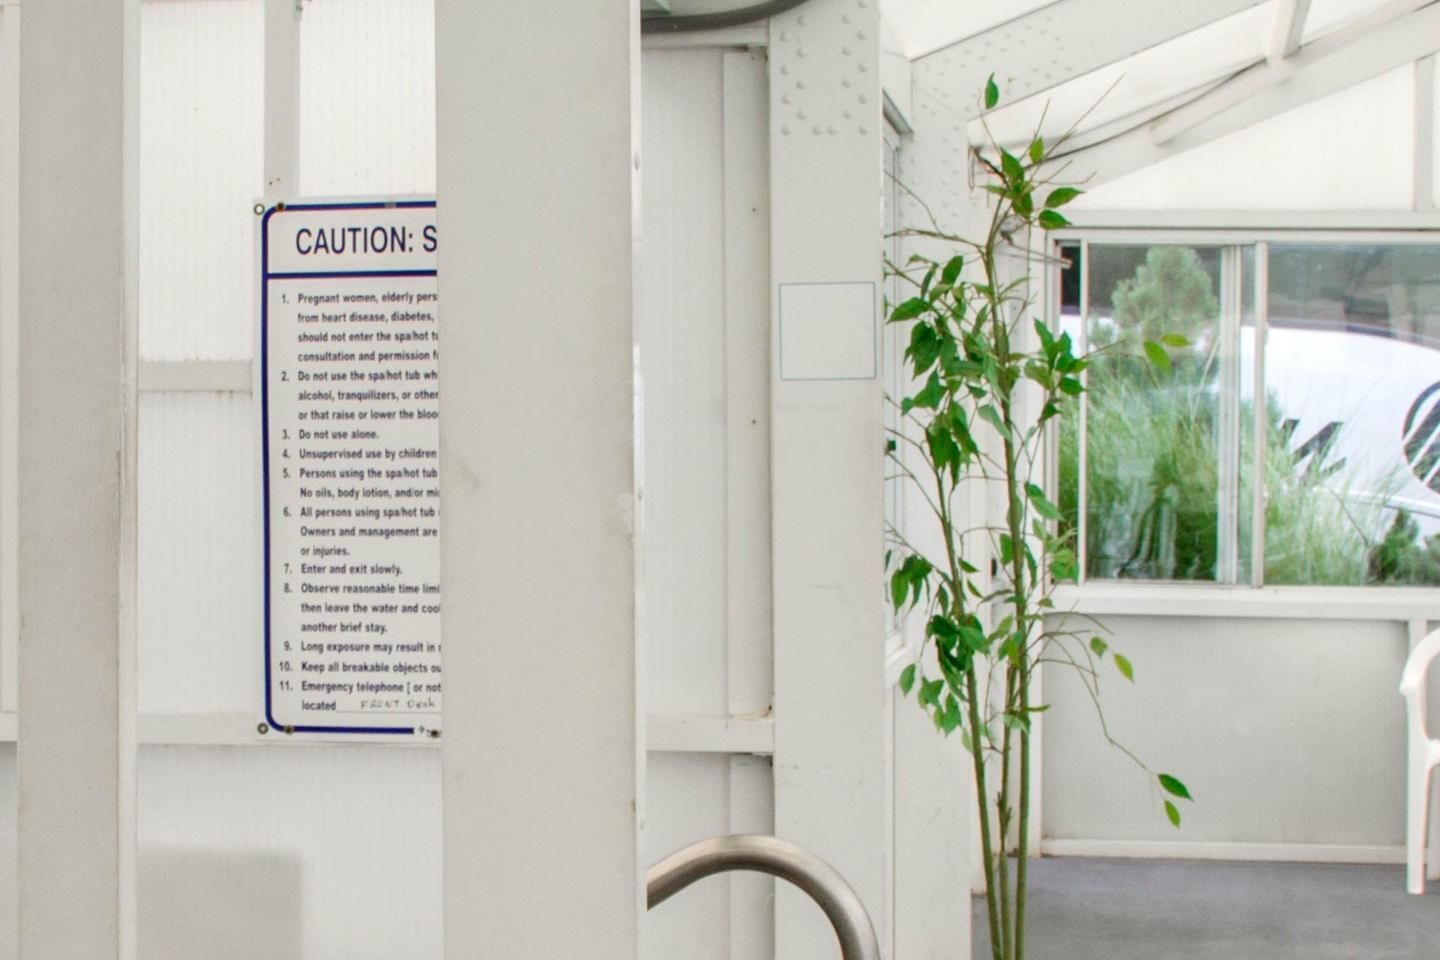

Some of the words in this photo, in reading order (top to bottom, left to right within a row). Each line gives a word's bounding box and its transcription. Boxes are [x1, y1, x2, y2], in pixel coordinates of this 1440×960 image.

[295, 227, 413, 254] CAUTION:
[423, 226, 438, 252] S
[282, 294, 289, 303] 1.
[298, 293, 339, 306] Pregnant
[344, 295, 378, 305] women,
[382, 292, 414, 304] elderly
[298, 313, 319, 322] from
[322, 313, 346, 322] heart
[349, 312, 388, 322] disease,
[391, 312, 434, 321] diabetes,
[298, 332, 328, 342] should
[331, 333, 346, 341] not
[349, 332, 373, 341] enter
[376, 332, 391, 341] the
[298, 352, 355, 362] consultation
[358, 351, 375, 361] and
[378, 351, 430, 362] permission
[281, 371, 289, 381] 2.
[298, 371, 310, 381] Do
[313, 372, 328, 381] not
[331, 373, 347, 381] use
[350, 371, 365, 380] the
[405, 370, 420, 380] tub
[298, 391, 334, 401] alcohol,
[338, 390, 398, 402] tranquilizers,
[402, 392, 411, 400] or
[298, 412, 308, 420] or
[311, 410, 329, 420] that
[332, 411, 355, 419] raise
[371, 410, 396, 419] lower
[399, 409, 414, 419] the
[417, 410, 439, 419] bloo
[283, 429, 290, 439] 3.
[299, 429, 311, 439] Do
[314, 430, 328, 439] not
[351, 430, 379, 439] alone.
[282, 449, 290, 458] 4.
[299, 449, 362, 460] Unsupervised
[385, 449, 396, 461] by
[399, 448, 436, 458] children
[283, 468, 291, 478] 5.
[300, 468, 336, 478] Persons
[339, 469, 364, 480] using
[367, 468, 382, 478] the
[422, 469, 437, 478] tub
[300, 488, 313, 497] No
[315, 488, 334, 498] oils,
[338, 488, 360, 500] body
[363, 488, 391, 498] lotion,
[283, 507, 291, 517] 6.
[300, 507, 312, 516] All
[315, 509, 352, 518] persons
[355, 508, 380, 519] using
[420, 508, 435, 517] tub
[300, 526, 336, 536] Owners
[339, 527, 356, 536] and
[359, 528, 419, 539] management
[313, 547, 350, 558] injuries.
[284, 563, 292, 573] 7.
[301, 563, 326, 574] Enter
[329, 564, 346, 574] and
[349, 564, 367, 574] exit
[370, 564, 402, 576] slowly.
[284, 583, 292, 593] 8.
[301, 583, 339, 593] Observe
[343, 584, 395, 593] reasonable
[399, 584, 419, 593] time
[301, 603, 321, 612] then
[325, 603, 350, 612] leave
[353, 603, 368, 613] the
[371, 604, 398, 613] water
[401, 603, 418, 613] and
[301, 622, 337, 632] another
[340, 622, 362, 632] brief
[365, 623, 387, 635] stay.
[284, 641, 292, 651] 9.
[301, 641, 324, 654] Long
[327, 644, 370, 654] exposure
[373, 644, 393, 654] may
[396, 642, 423, 652] result
[427, 642, 435, 652] in
[279, 661, 292, 671] 10.
[301, 661, 325, 674] Keep
[328, 662, 339, 672] all
[342, 662, 389, 672] breakable
[393, 663, 428, 675] objects
[280, 681, 292, 690] 11.
[302, 681, 353, 694] Emergency
[357, 682, 404, 693] telephone
[302, 701, 336, 711] located
